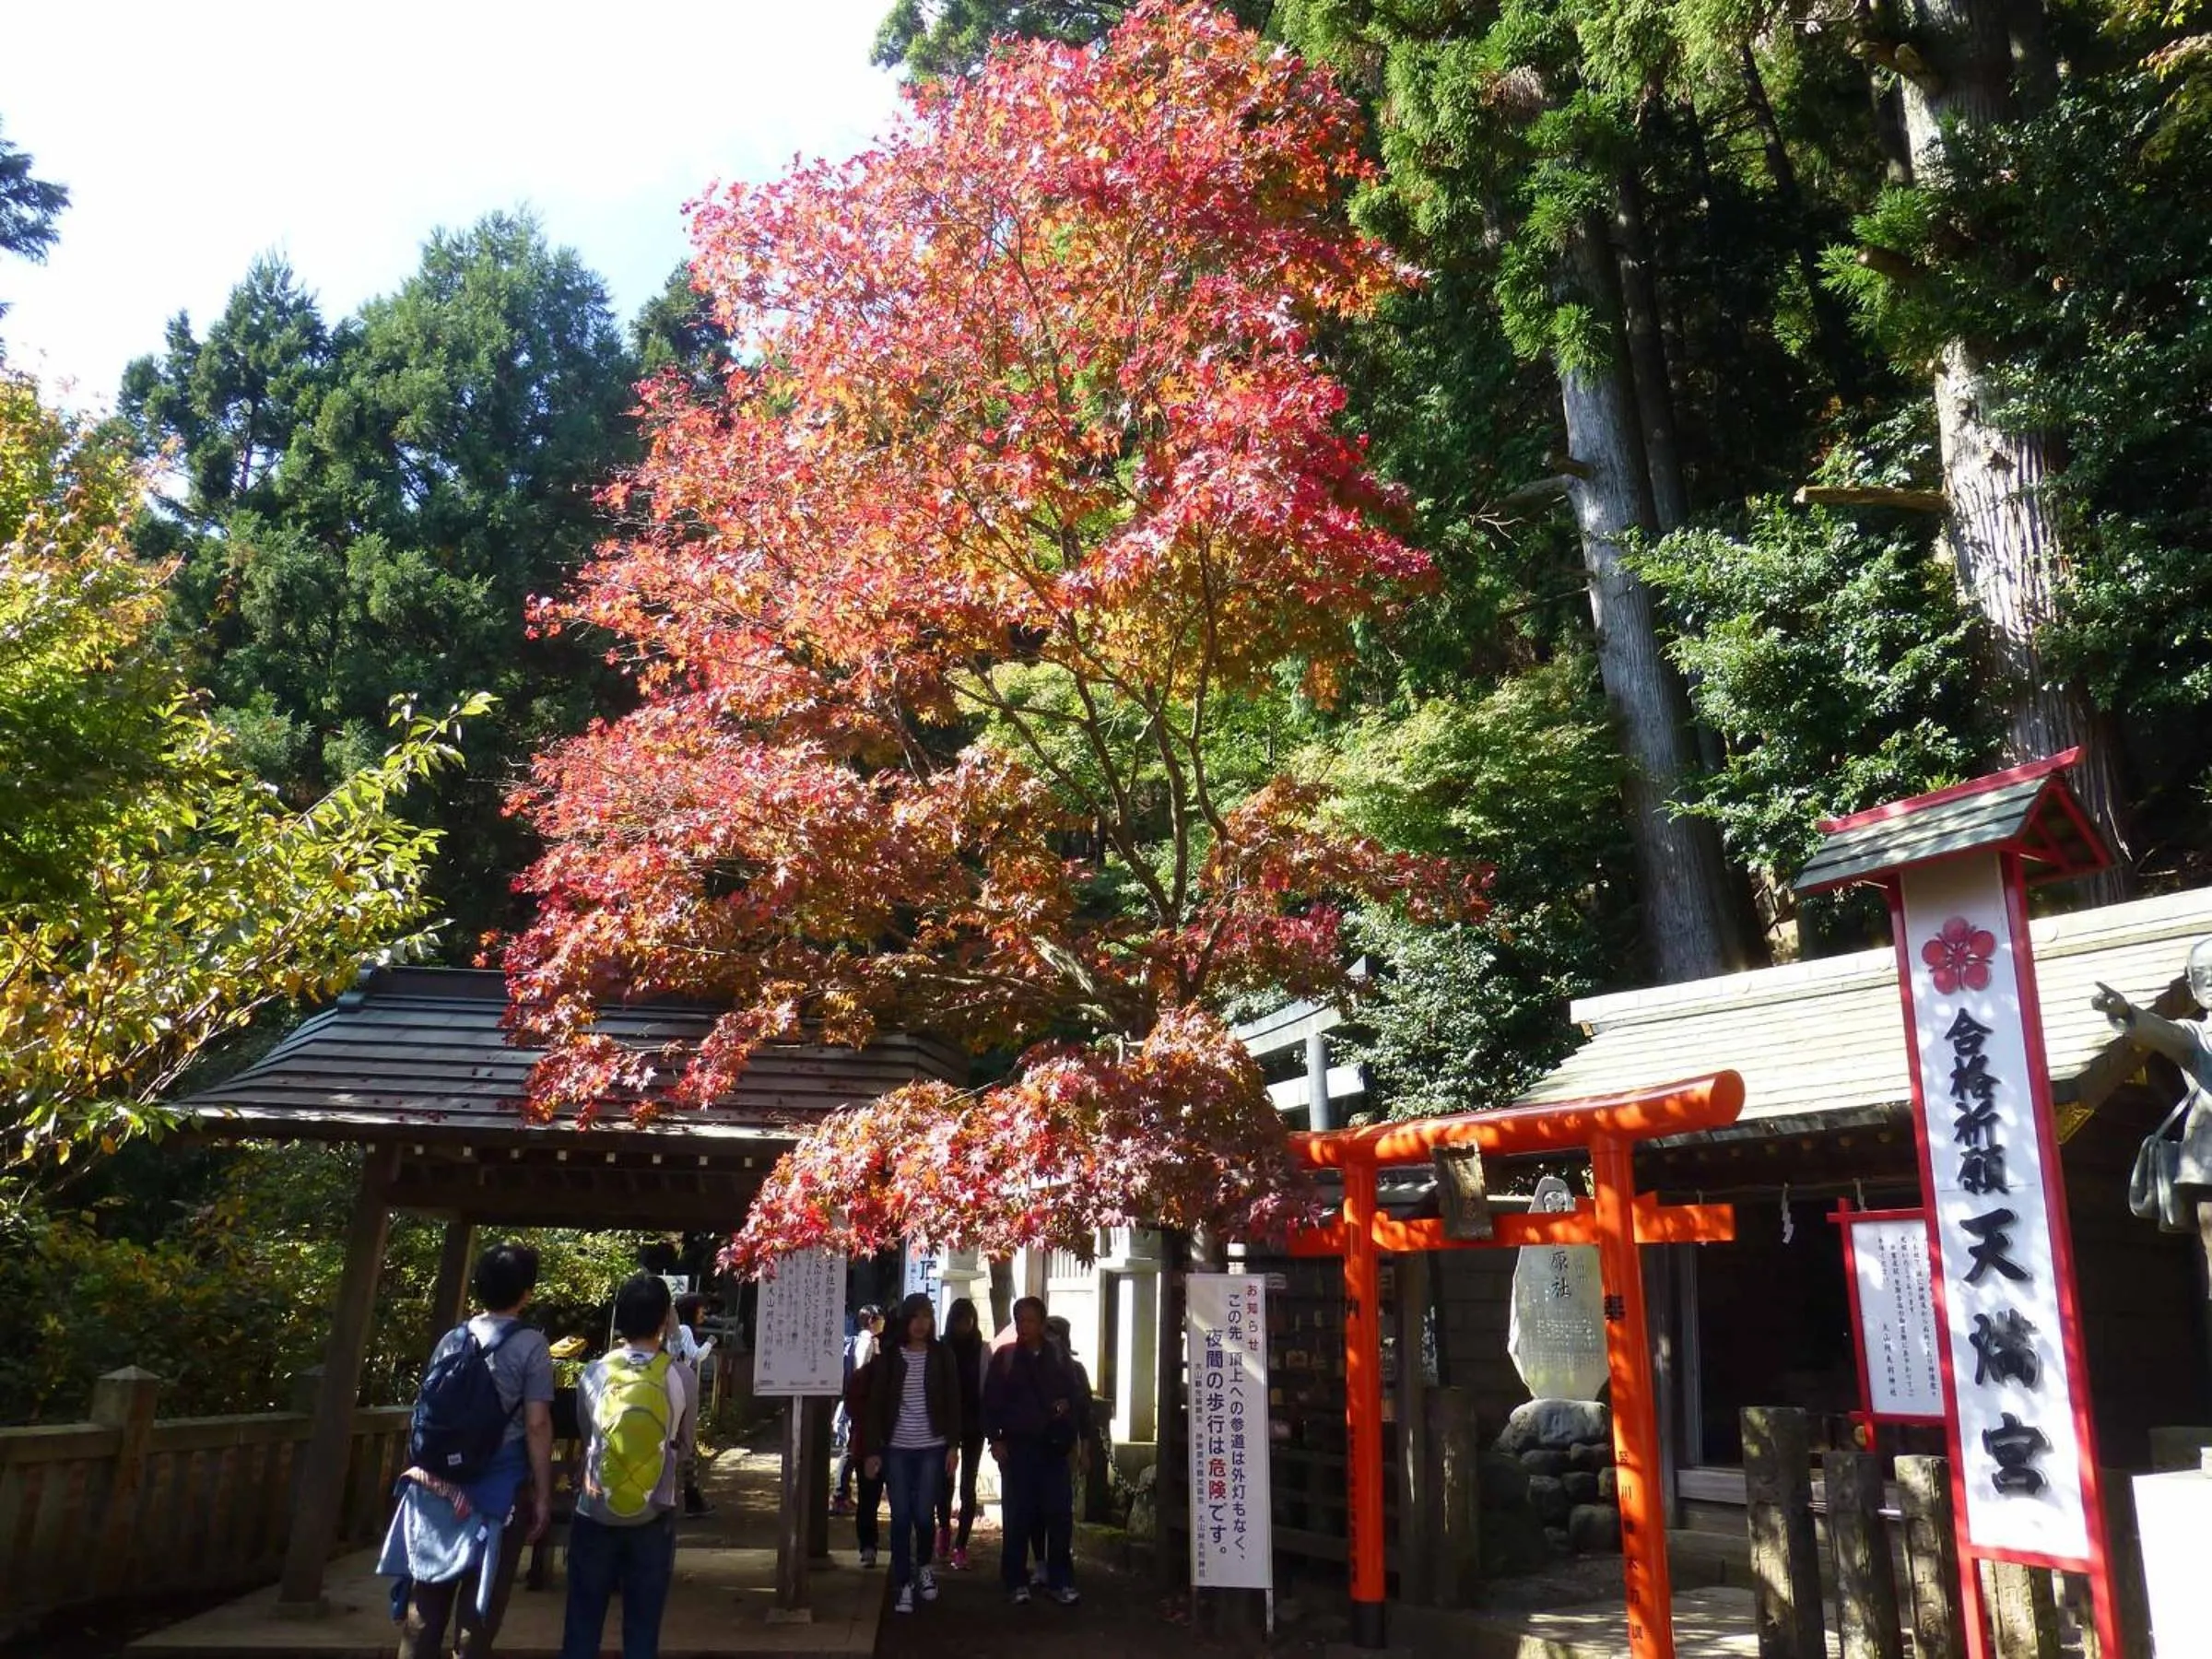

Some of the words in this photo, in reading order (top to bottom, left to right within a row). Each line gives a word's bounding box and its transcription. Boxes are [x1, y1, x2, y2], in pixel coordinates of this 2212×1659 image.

[1944, 1008, 2010, 1196] 合格祈願
[1228, 1294, 1242, 1340] この先
[1246, 1285, 1259, 1352] お知らせ
[1961, 1208, 2052, 1498] 天満宮
[1206, 1329, 1228, 1555] 夜間の歩行は危険です。
